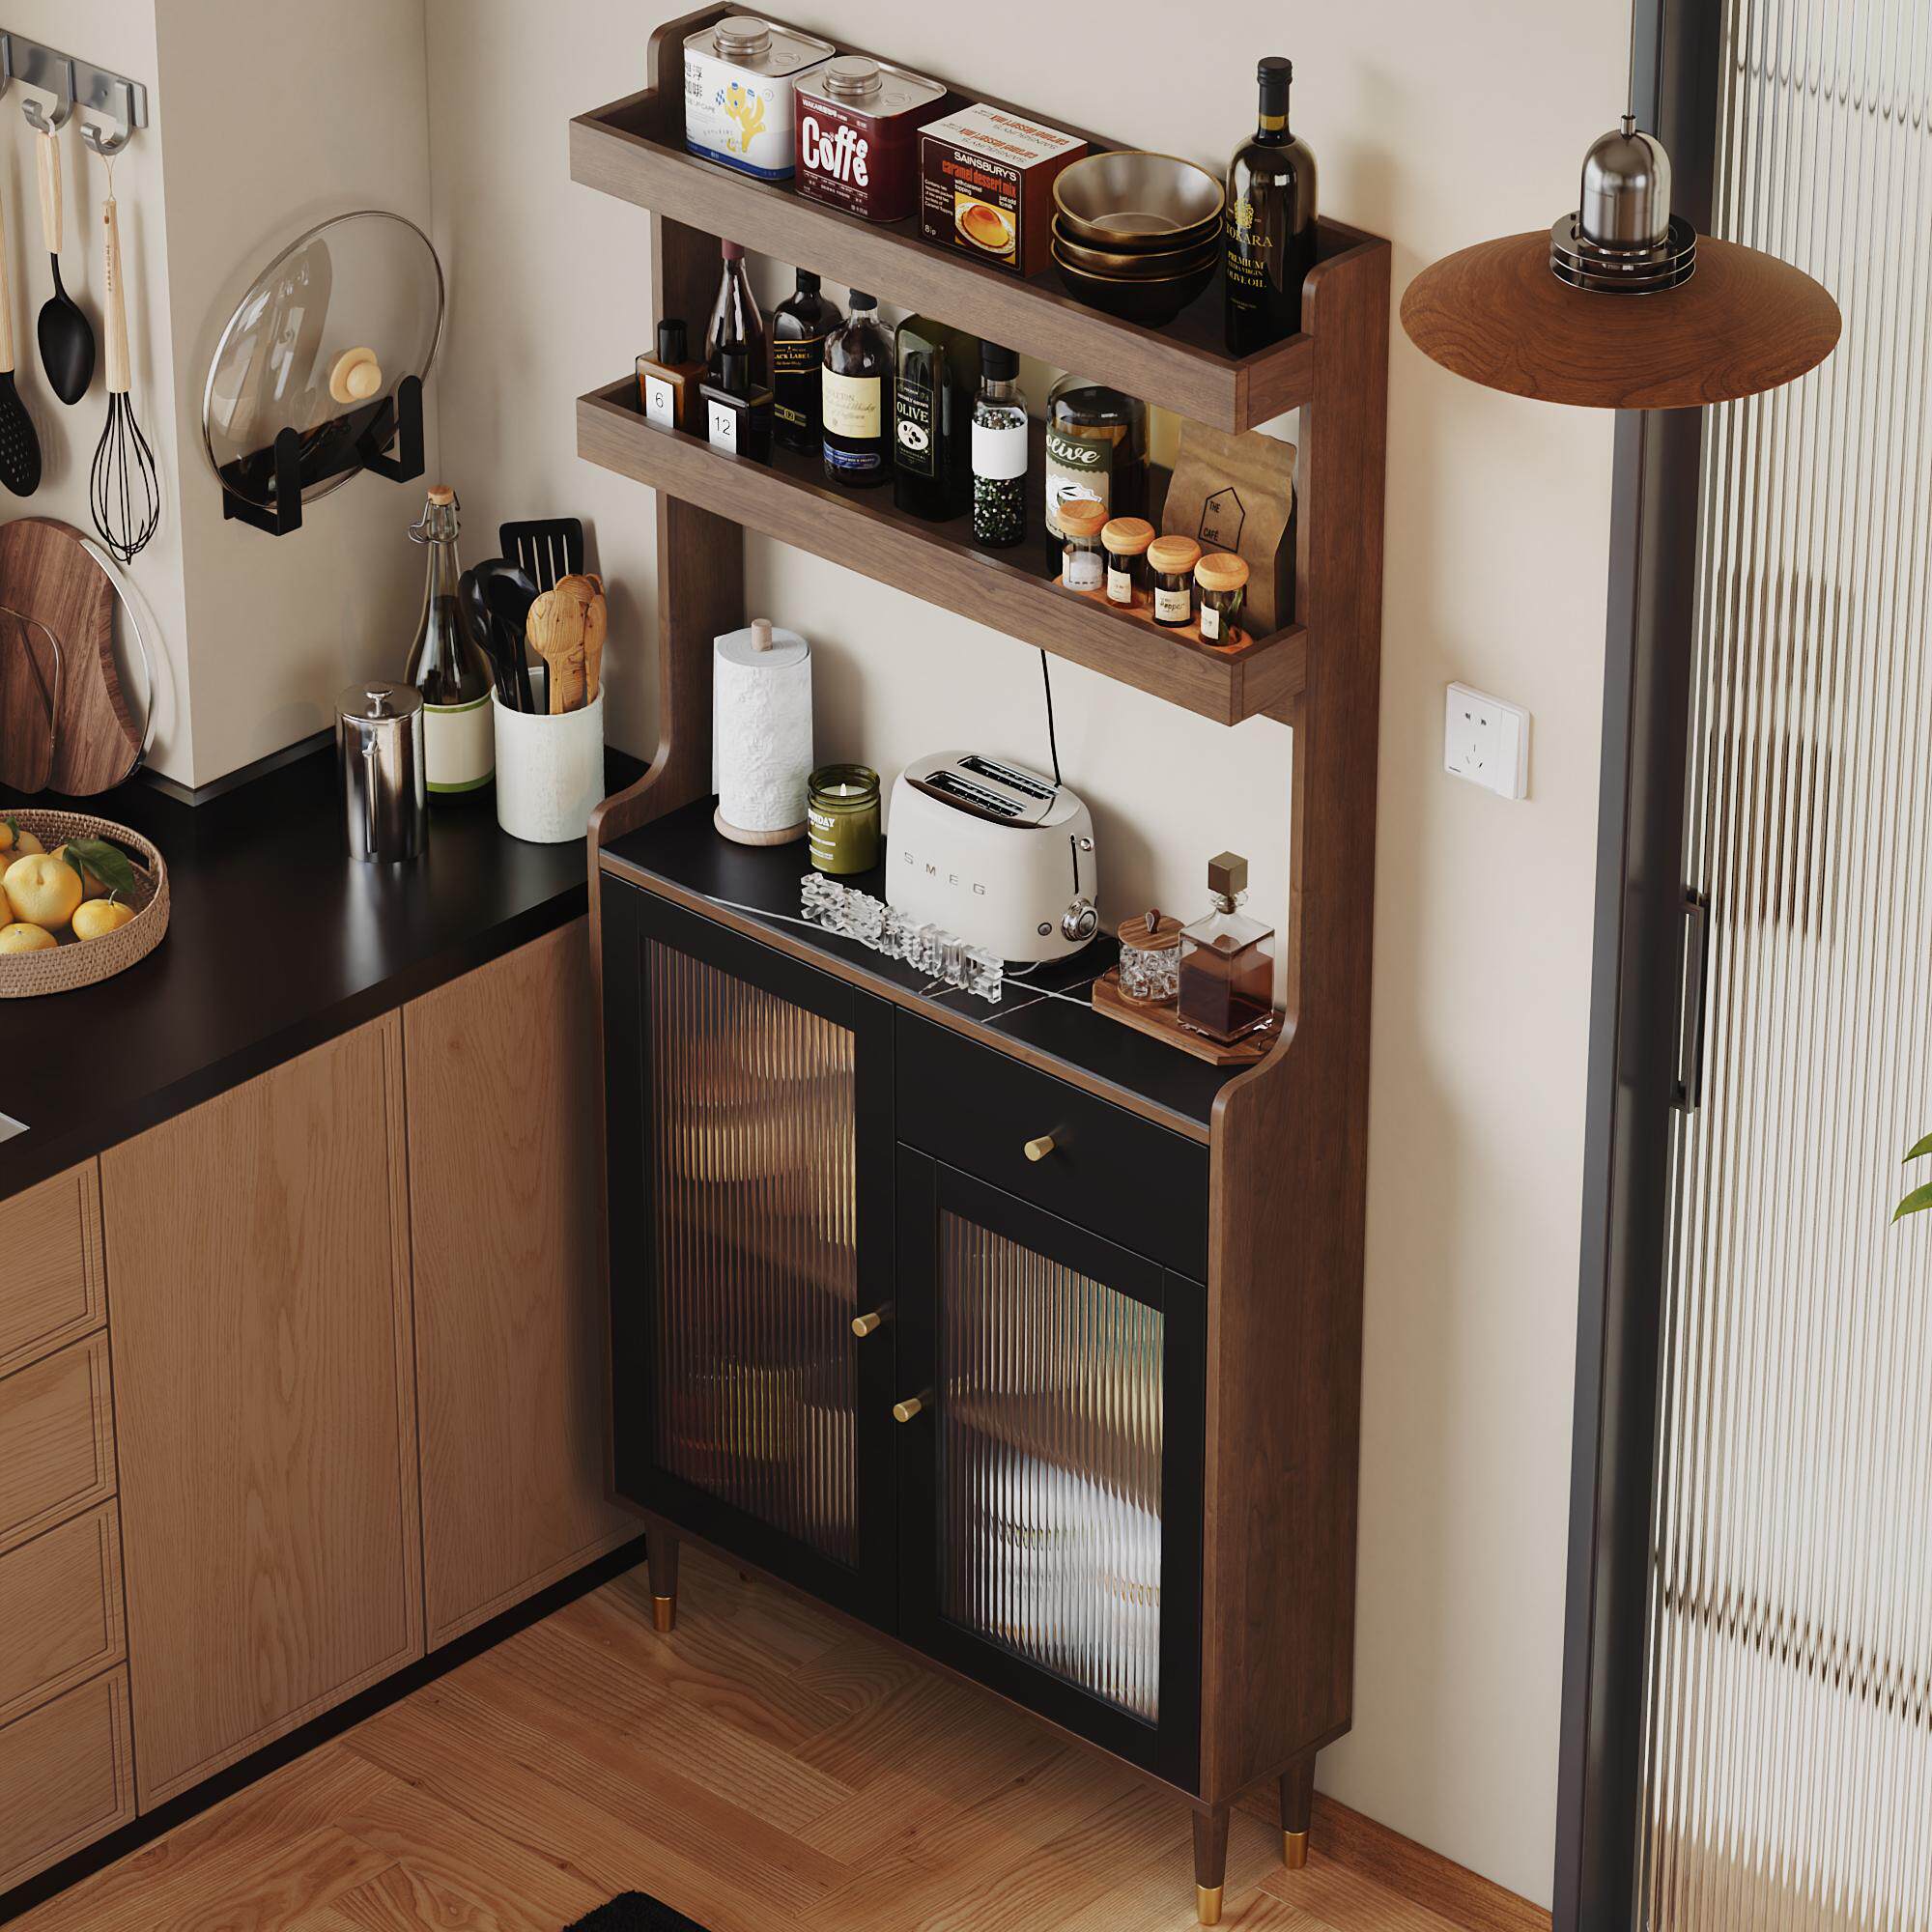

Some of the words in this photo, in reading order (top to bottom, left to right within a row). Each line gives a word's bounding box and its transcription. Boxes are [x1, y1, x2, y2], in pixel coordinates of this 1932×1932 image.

[953, 151, 1017, 182] SAINSBURY'S
[942, 159, 973, 185] caramel
[973, 171, 1002, 194] dessert
[1002, 182, 1016, 198] mix
[1228, 250, 1265, 270] PREMIUM
[655, 392, 664, 409] 6
[896, 401, 929, 423] OLIVE
[715, 416, 730, 436] 12
[1209, 500, 1221, 514] THE
[903, 851, 986, 896] SMEG
